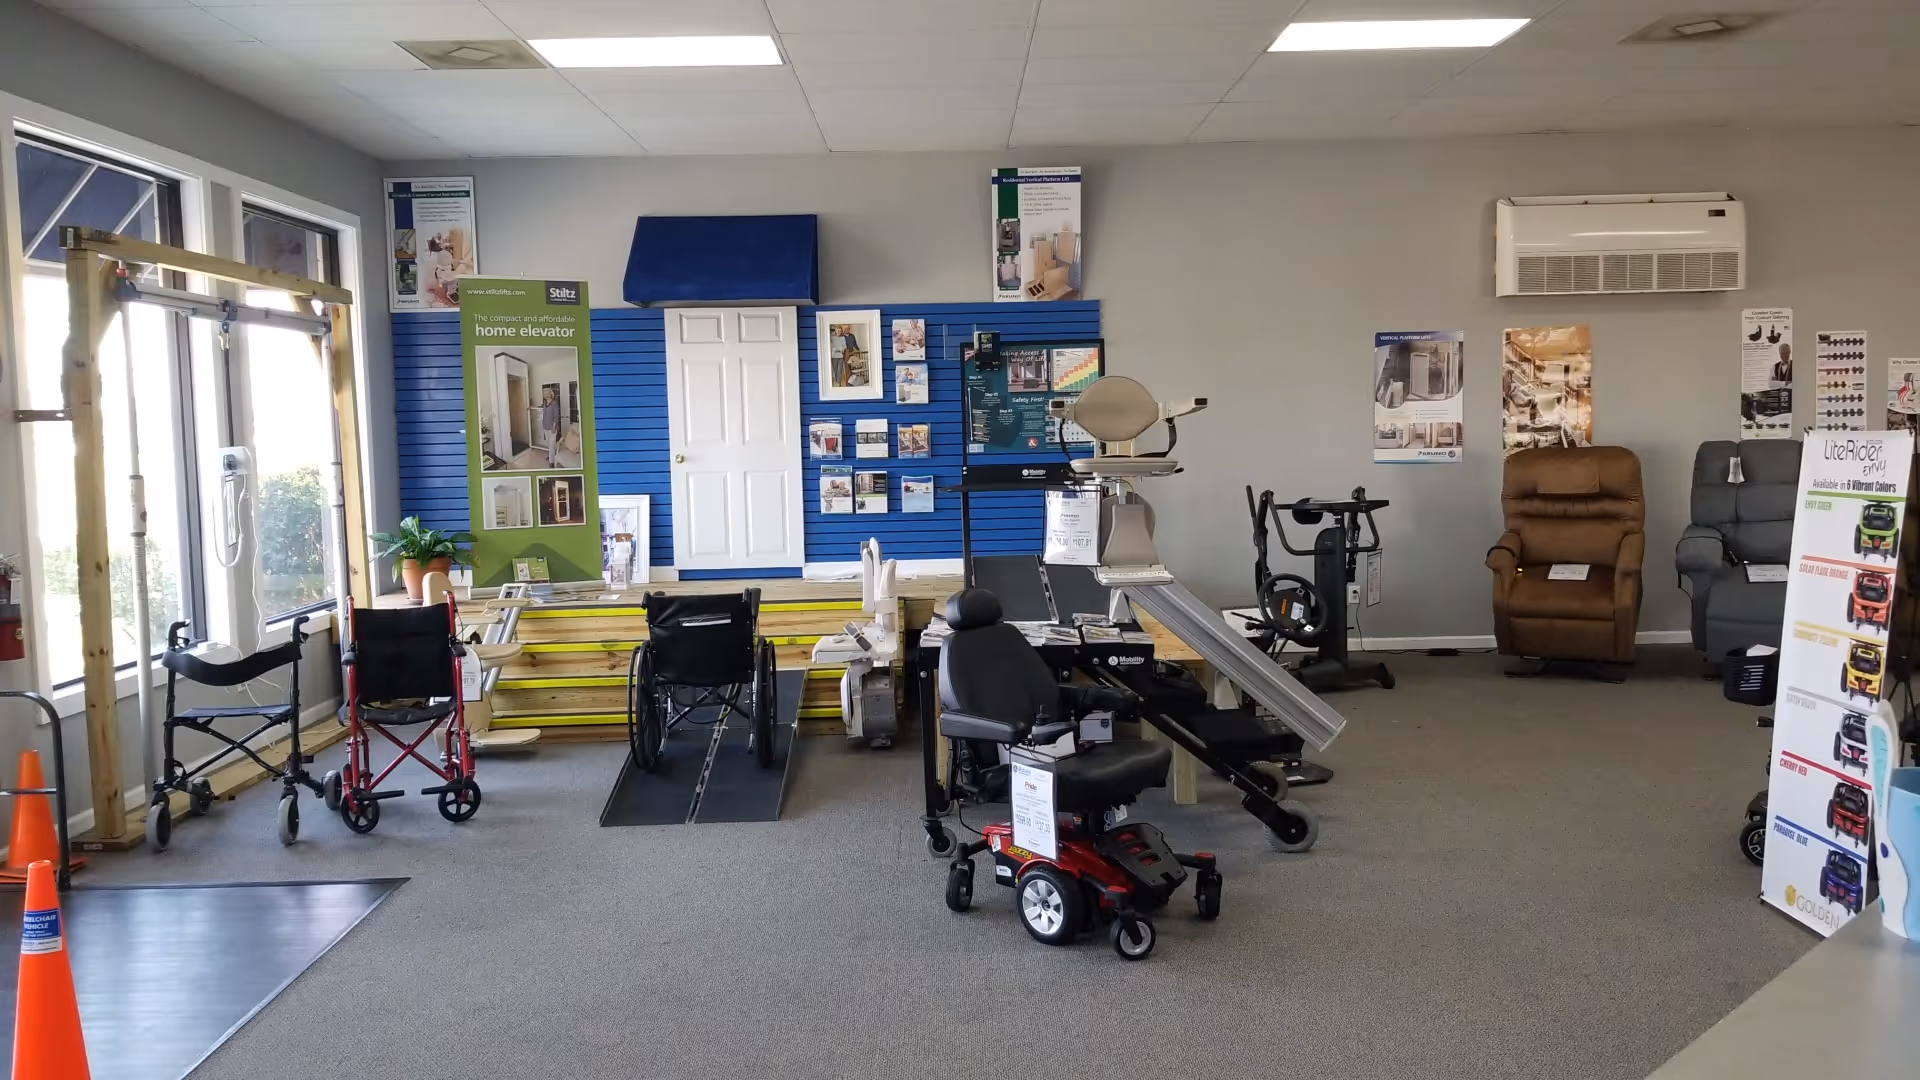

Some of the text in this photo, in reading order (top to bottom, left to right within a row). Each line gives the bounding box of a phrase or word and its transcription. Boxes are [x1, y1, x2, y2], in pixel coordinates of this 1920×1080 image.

[550, 288, 576, 298] Stiltz
[489, 314, 521, 323] compact
[475, 324, 576, 337] home elevator
[1824, 439, 1882, 461] LiteRider
[1812, 479, 1896, 493] Available in 6 Vibrant Colors
[1799, 563, 1849, 580] SOLAR FLARE ORANGE
[1780, 758, 1807, 776] CHERRY RED
[1025, 781, 1037, 790] Pride
[1773, 822, 1808, 846] PARADISE BLUE
[1797, 895, 1839, 929] GOLDEN
